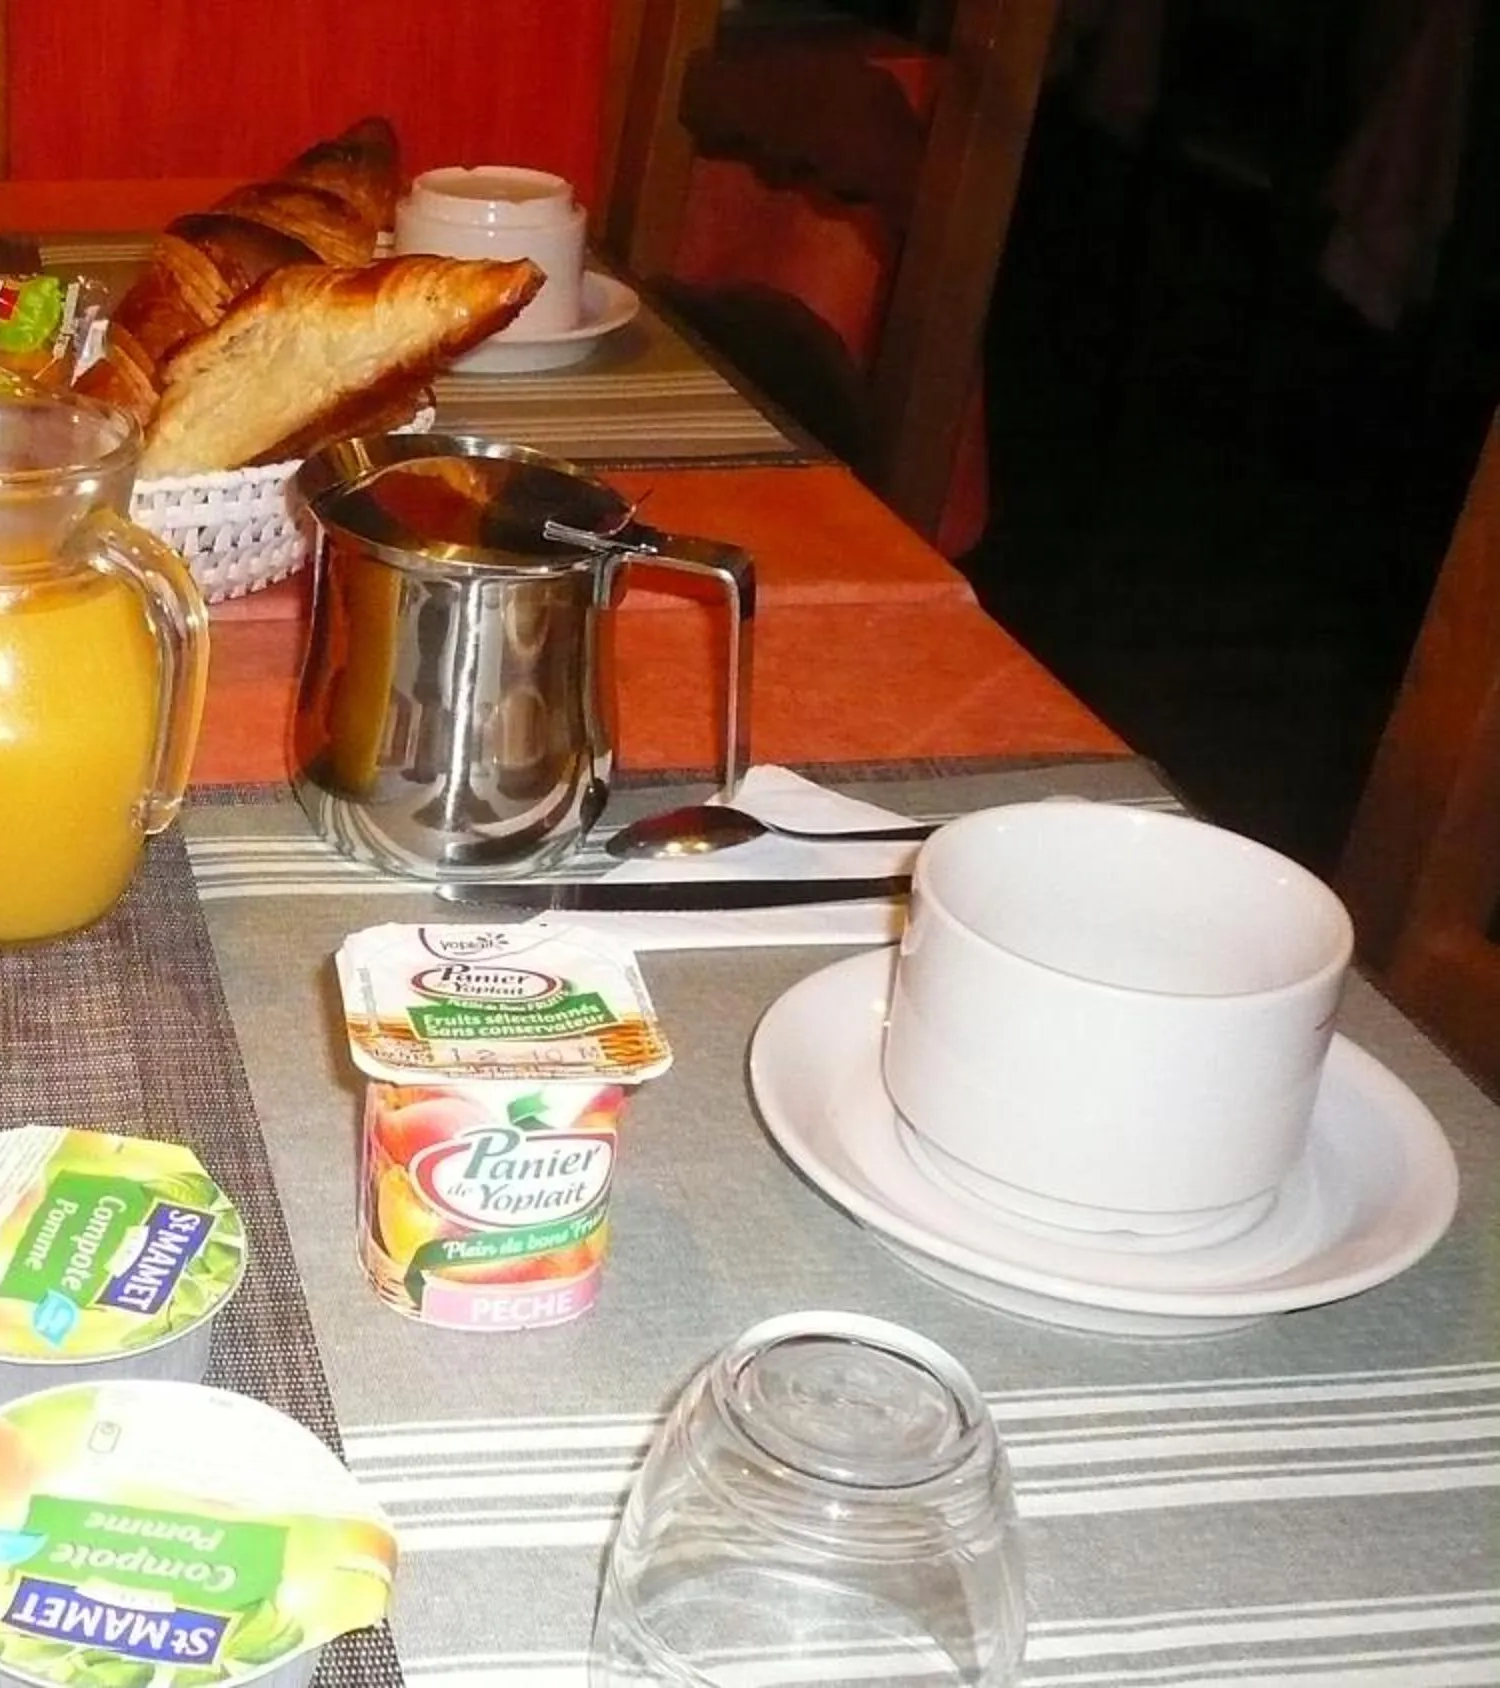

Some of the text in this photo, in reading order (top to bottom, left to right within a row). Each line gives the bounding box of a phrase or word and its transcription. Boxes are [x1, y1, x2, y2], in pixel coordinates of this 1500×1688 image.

[442, 963, 529, 985] Panier
[424, 1013, 481, 1027] Fruits
[485, 1003, 600, 1024] sélectionnés
[426, 1014, 605, 1037] Sans conservateur
[461, 1127, 602, 1180] Panier
[478, 1181, 588, 1214] Yoplait
[24, 1197, 80, 1272] Pomme
[61, 1195, 128, 1292] Compote
[118, 1229, 190, 1311] MAMET
[83, 1510, 227, 1552] Pomme
[49, 1542, 237, 1593] Compote
[12, 1591, 171, 1652] MAMET
